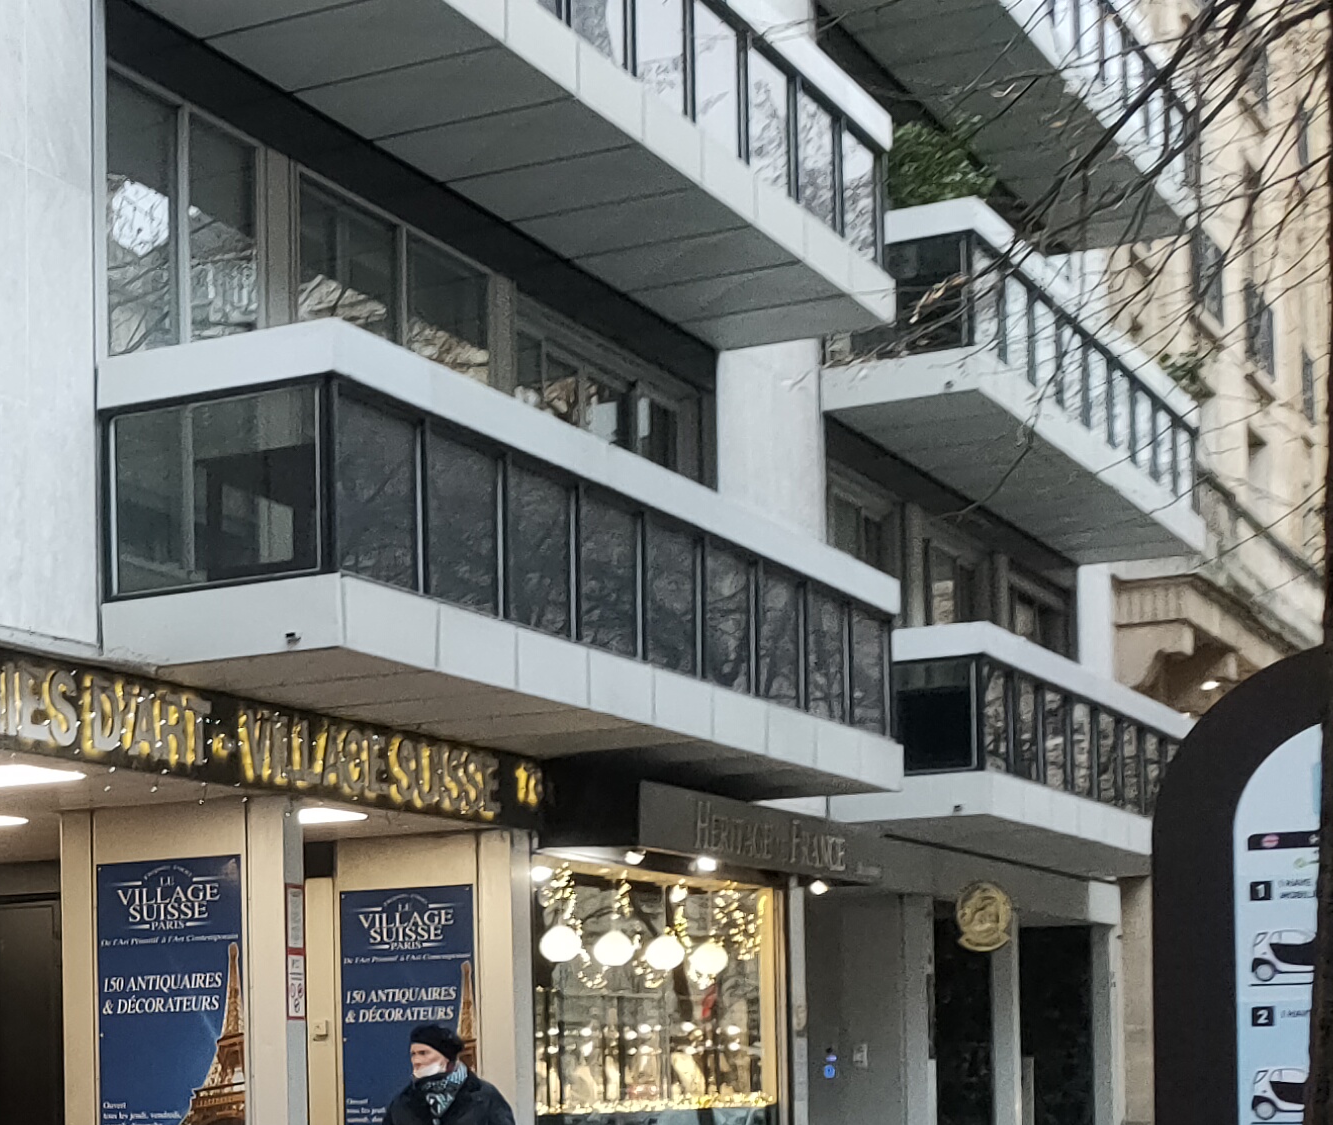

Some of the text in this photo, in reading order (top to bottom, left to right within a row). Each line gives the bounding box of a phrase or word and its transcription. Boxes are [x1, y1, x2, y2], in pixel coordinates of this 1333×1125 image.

[90, 682, 213, 767] D'ART
[239, 709, 390, 795] VILLAGE
[390, 738, 501, 820] SUISSE
[117, 883, 221, 906] VILLAGE
[1256, 884, 1265, 898] 1
[128, 901, 209, 922] SUISSE
[358, 909, 454, 929] VILLAGE
[151, 920, 186, 931] PARIS
[369, 925, 443, 944] SUISSE
[104, 972, 223, 993] 150 ANTIQUAIRES
[346, 986, 457, 1004] 150 ANTIQUAIRES
[102, 995, 220, 1015] & DÉCORATEURS
[344, 1005, 454, 1024] & DÉCORATEURS
[1256, 1009, 1269, 1024] 2
